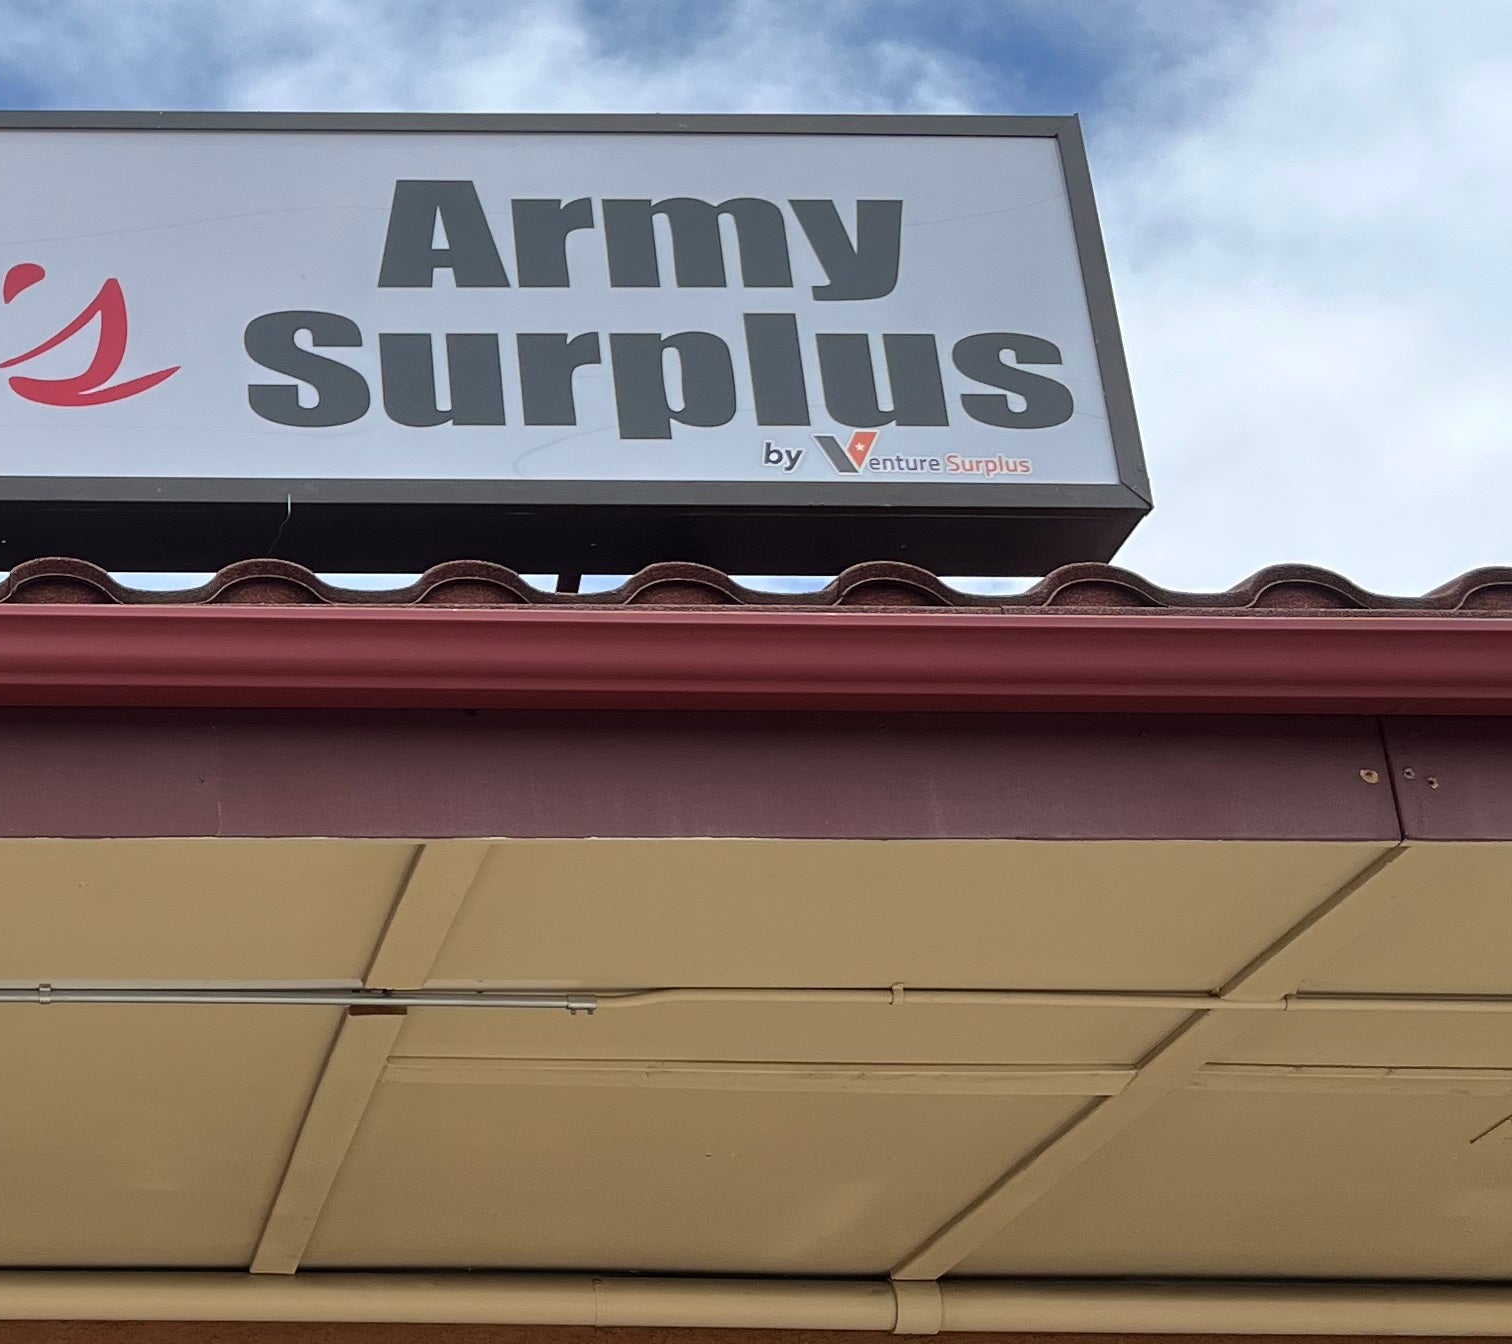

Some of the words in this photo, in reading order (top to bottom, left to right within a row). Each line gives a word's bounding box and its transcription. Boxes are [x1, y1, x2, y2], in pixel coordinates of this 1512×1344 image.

[377, 179, 904, 302] Army
[243, 309, 1076, 441] Surplus
[763, 441, 803, 472] by
[813, 431, 941, 474] Venture
[945, 455, 1031, 476] Surplus
